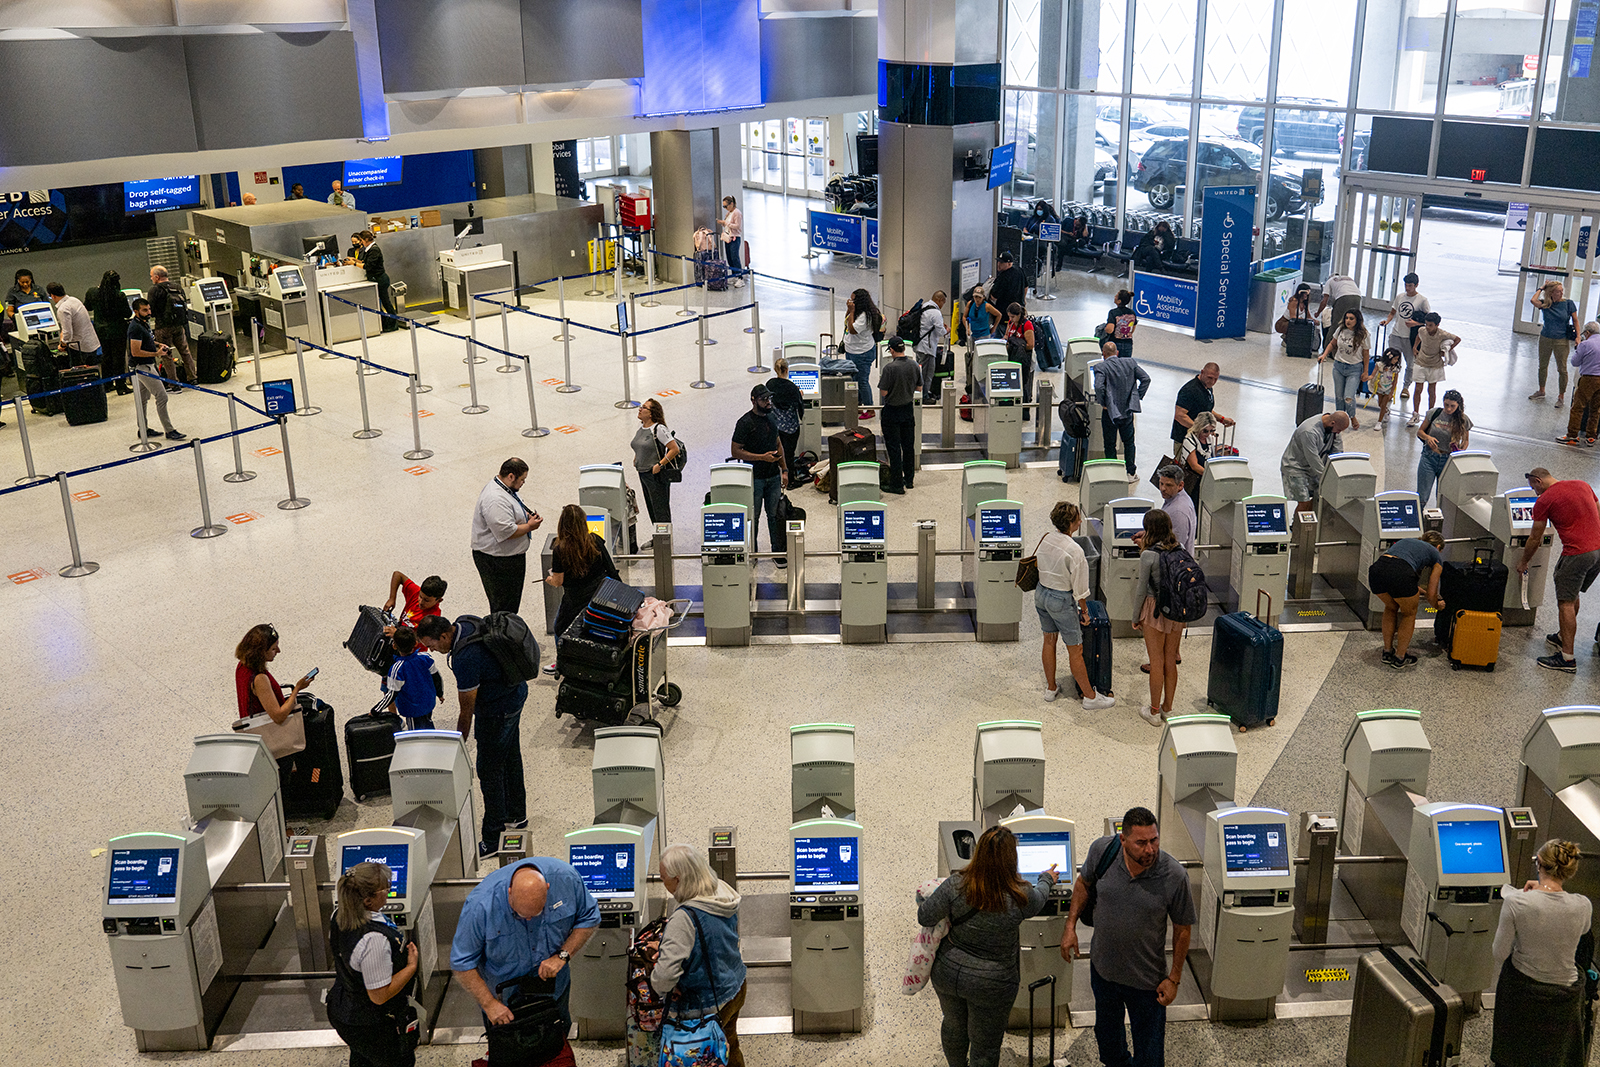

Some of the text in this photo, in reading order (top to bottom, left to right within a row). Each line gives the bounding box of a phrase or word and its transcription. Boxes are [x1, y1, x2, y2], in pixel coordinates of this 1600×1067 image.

[348, 168, 388, 176] Unaccompanied
[1471, 169, 1486, 180] EXIT
[150, 185, 192, 196] self-tagged
[13, 206, 52, 218] Access
[826, 228, 844, 236] Mobility
[827, 235, 849, 243] Assistance
[1216, 232, 1232, 328] Special Services
[1156, 294, 1183, 306] Mobility
[1156, 302, 1189, 315] Assistance
[1156, 311, 1170, 319] area
